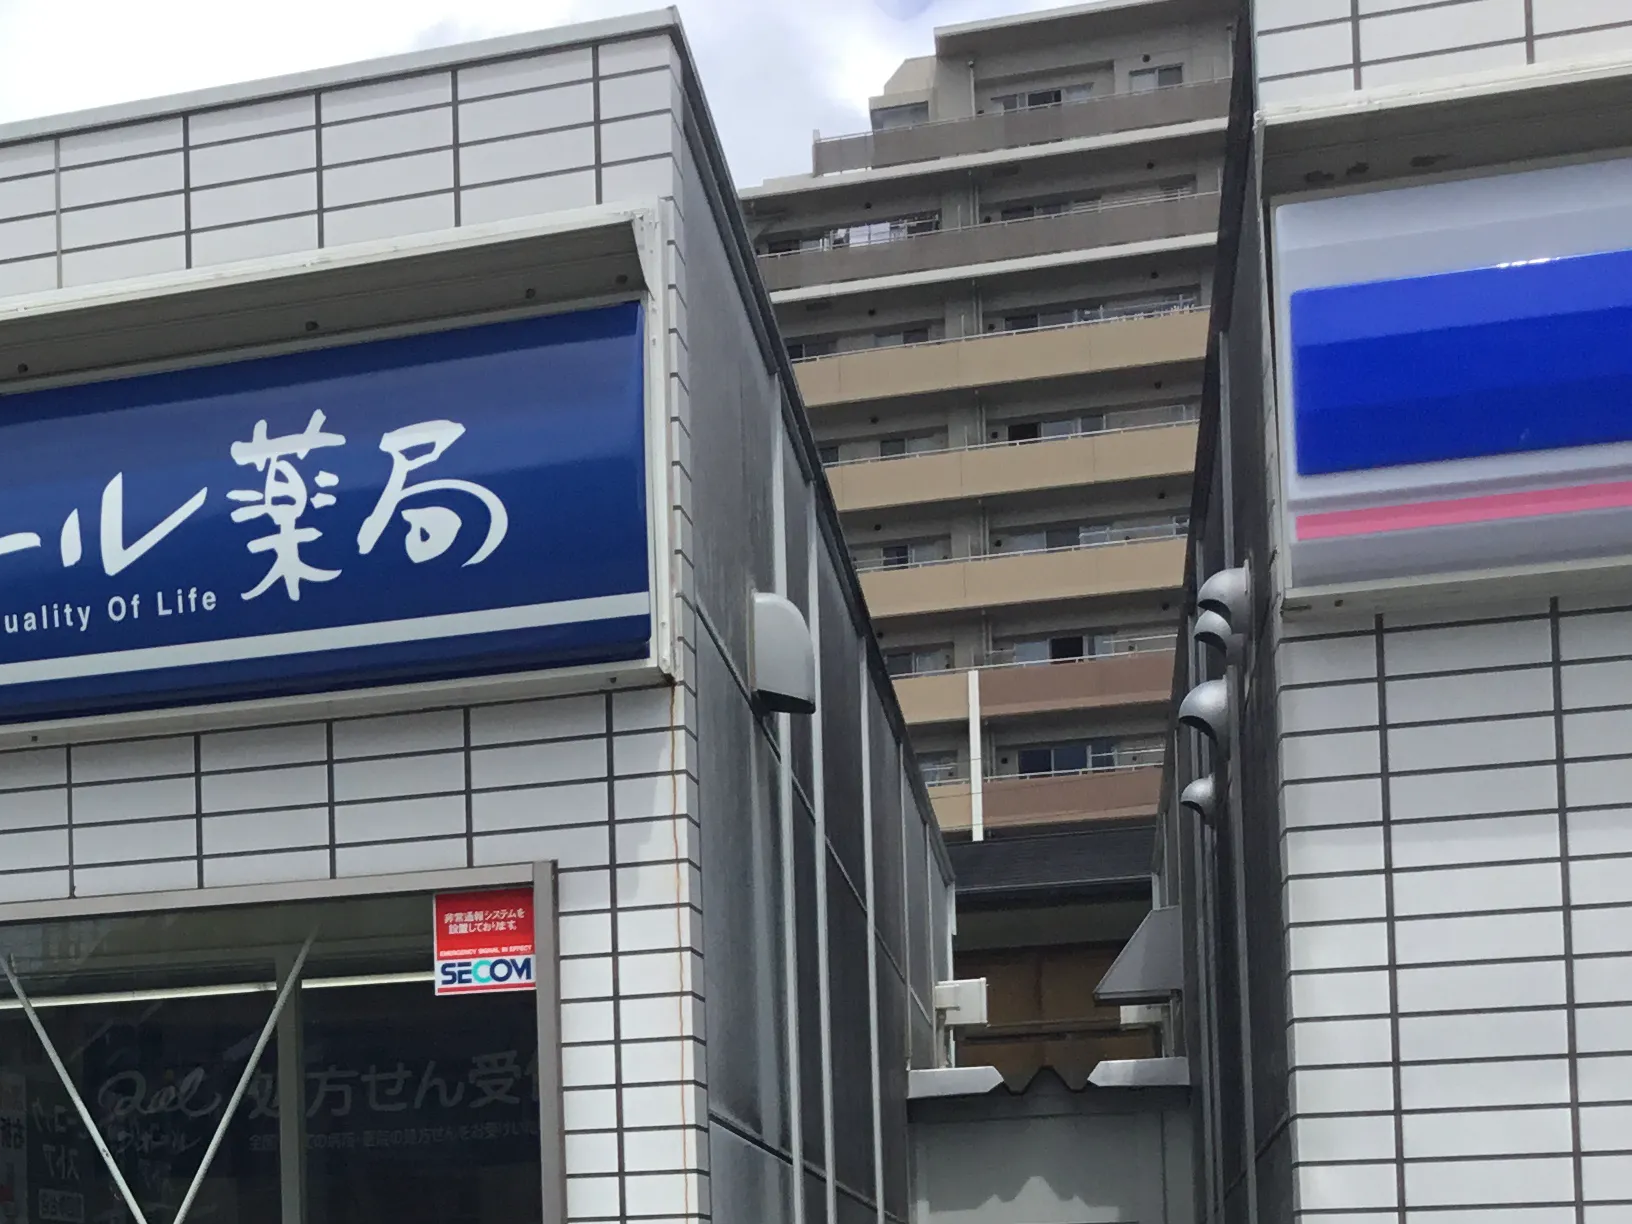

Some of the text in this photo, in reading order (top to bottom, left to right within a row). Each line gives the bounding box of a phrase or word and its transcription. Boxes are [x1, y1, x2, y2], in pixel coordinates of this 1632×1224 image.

[107, 594, 141, 622] Of
[156, 586, 217, 616] Life
[441, 957, 532, 985] SECOM
[246, 1050, 539, 1120] 処方せん受
